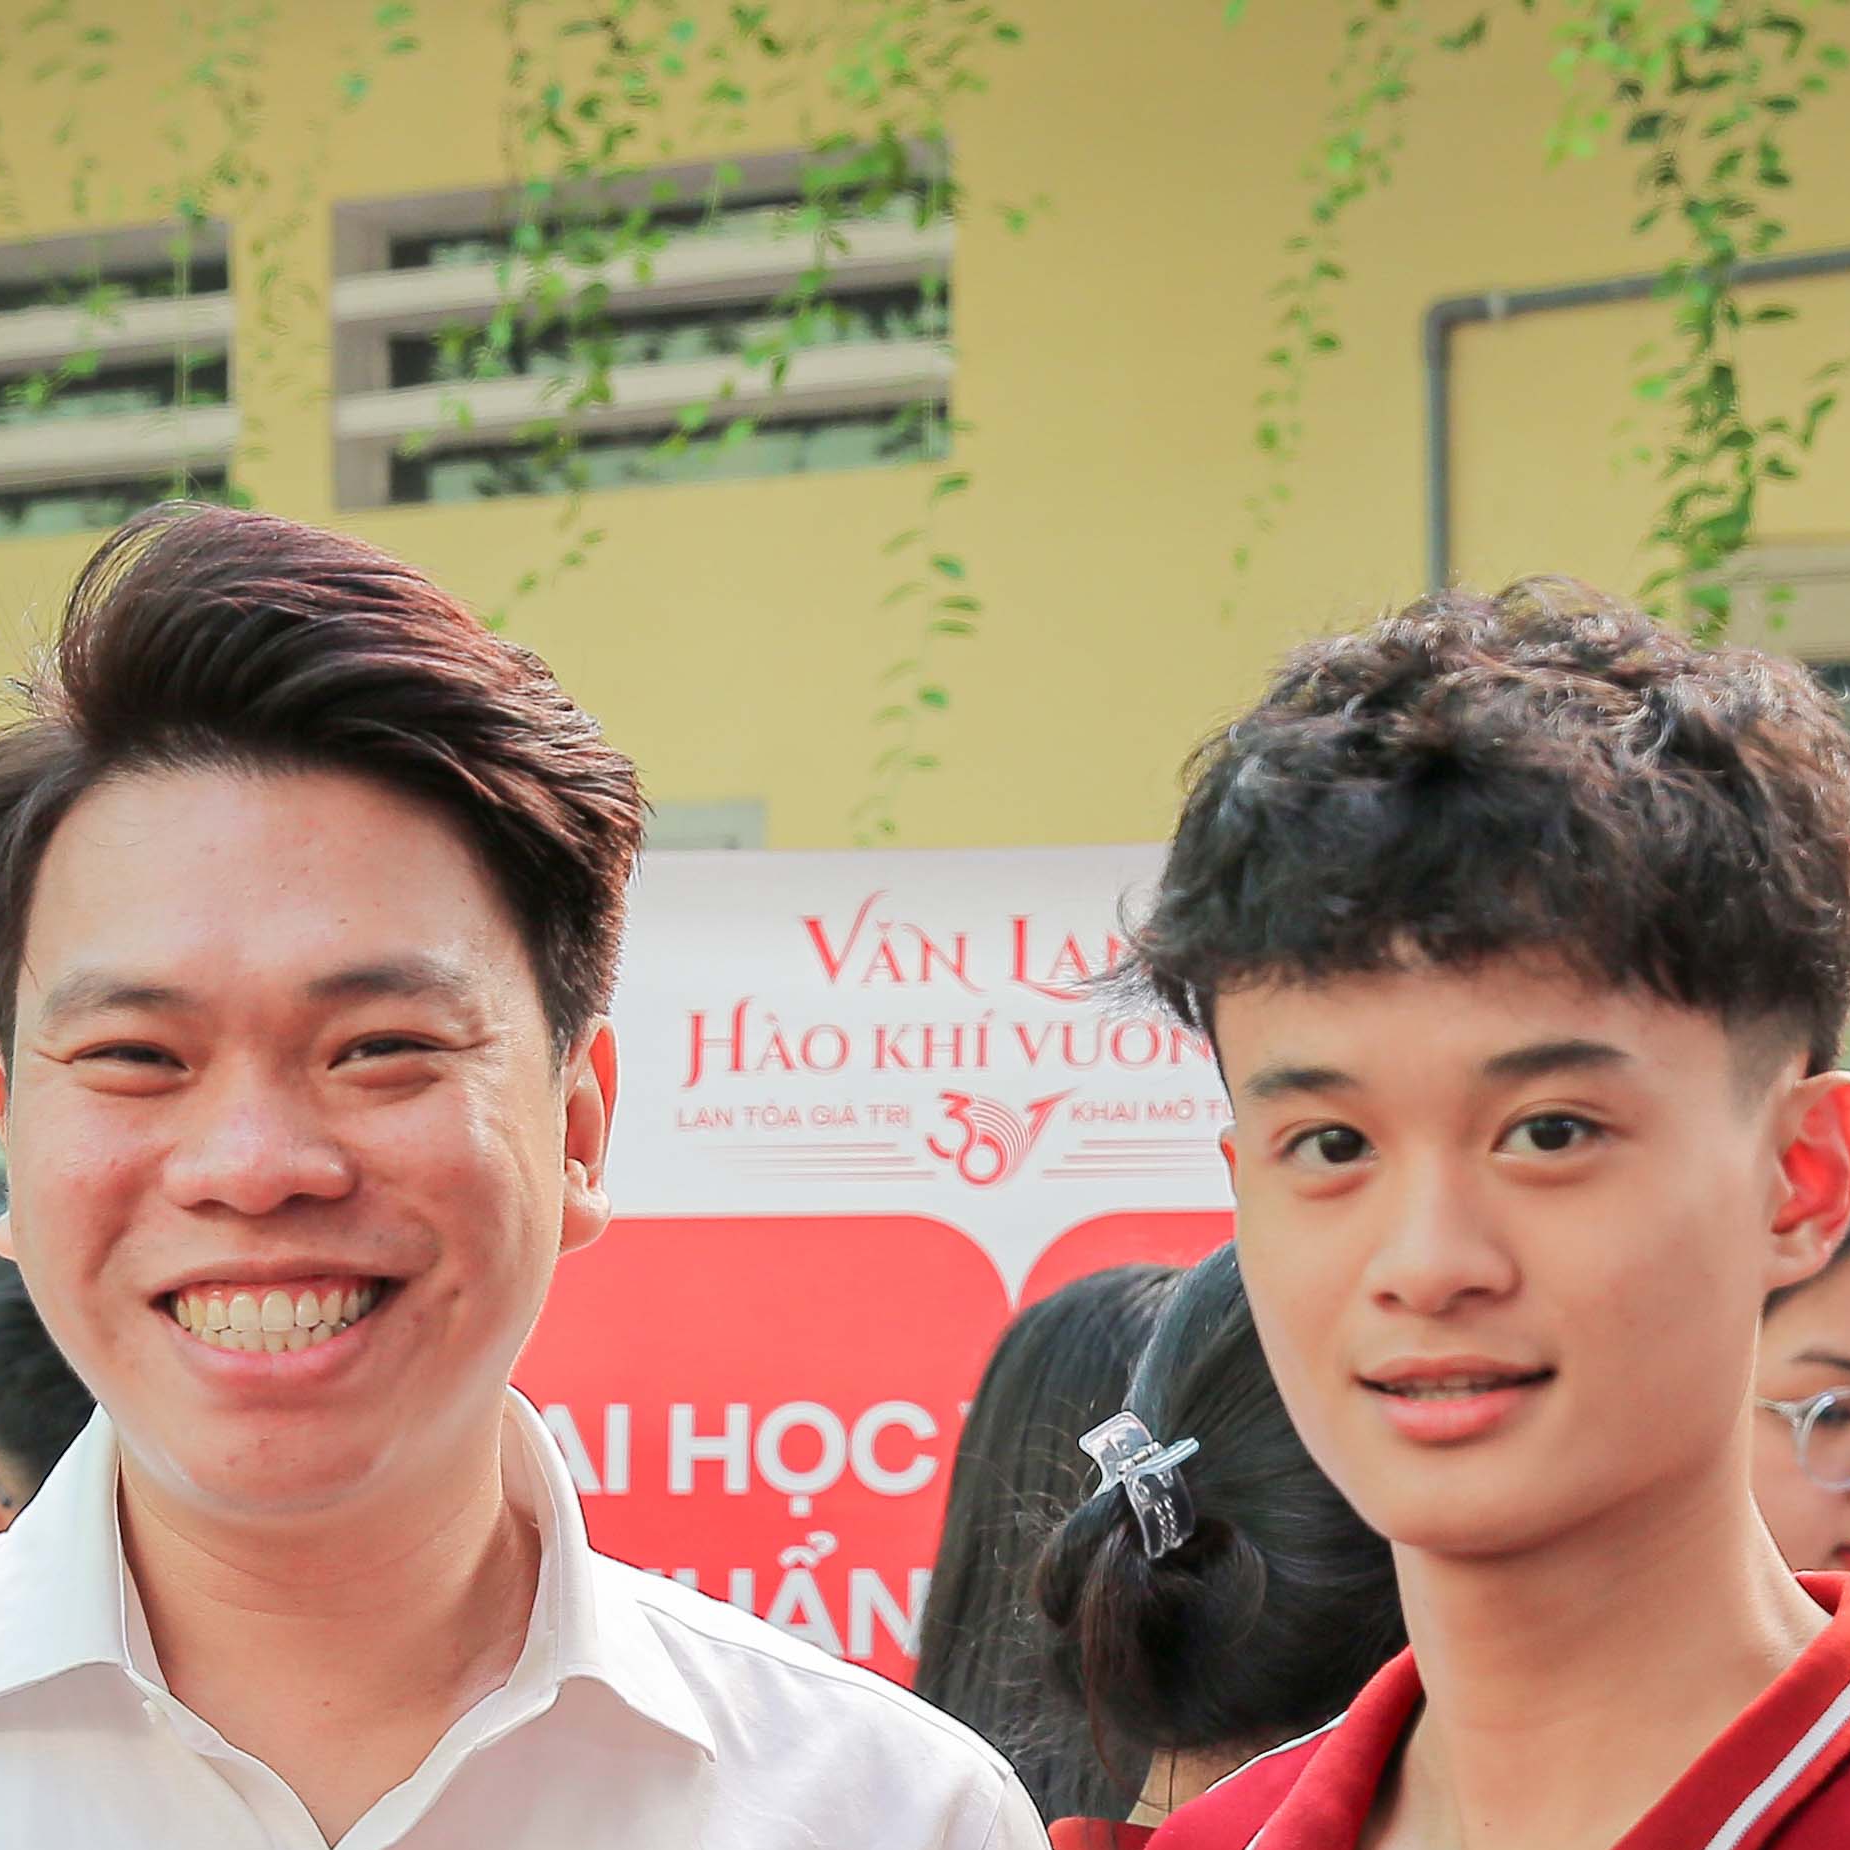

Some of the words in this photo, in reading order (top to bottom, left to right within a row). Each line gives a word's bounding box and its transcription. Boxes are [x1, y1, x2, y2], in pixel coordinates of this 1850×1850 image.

[798, 889, 987, 994] VĂN
[679, 995, 851, 1091] HÀO
[871, 1009, 996, 1070] KHÍ
[1011, 1011, 1215, 1070] VƯƠN
[675, 1105, 734, 1128] LAN
[1070, 1102, 1140, 1122] KHAI
[668, 1400, 939, 1518] HỌC
